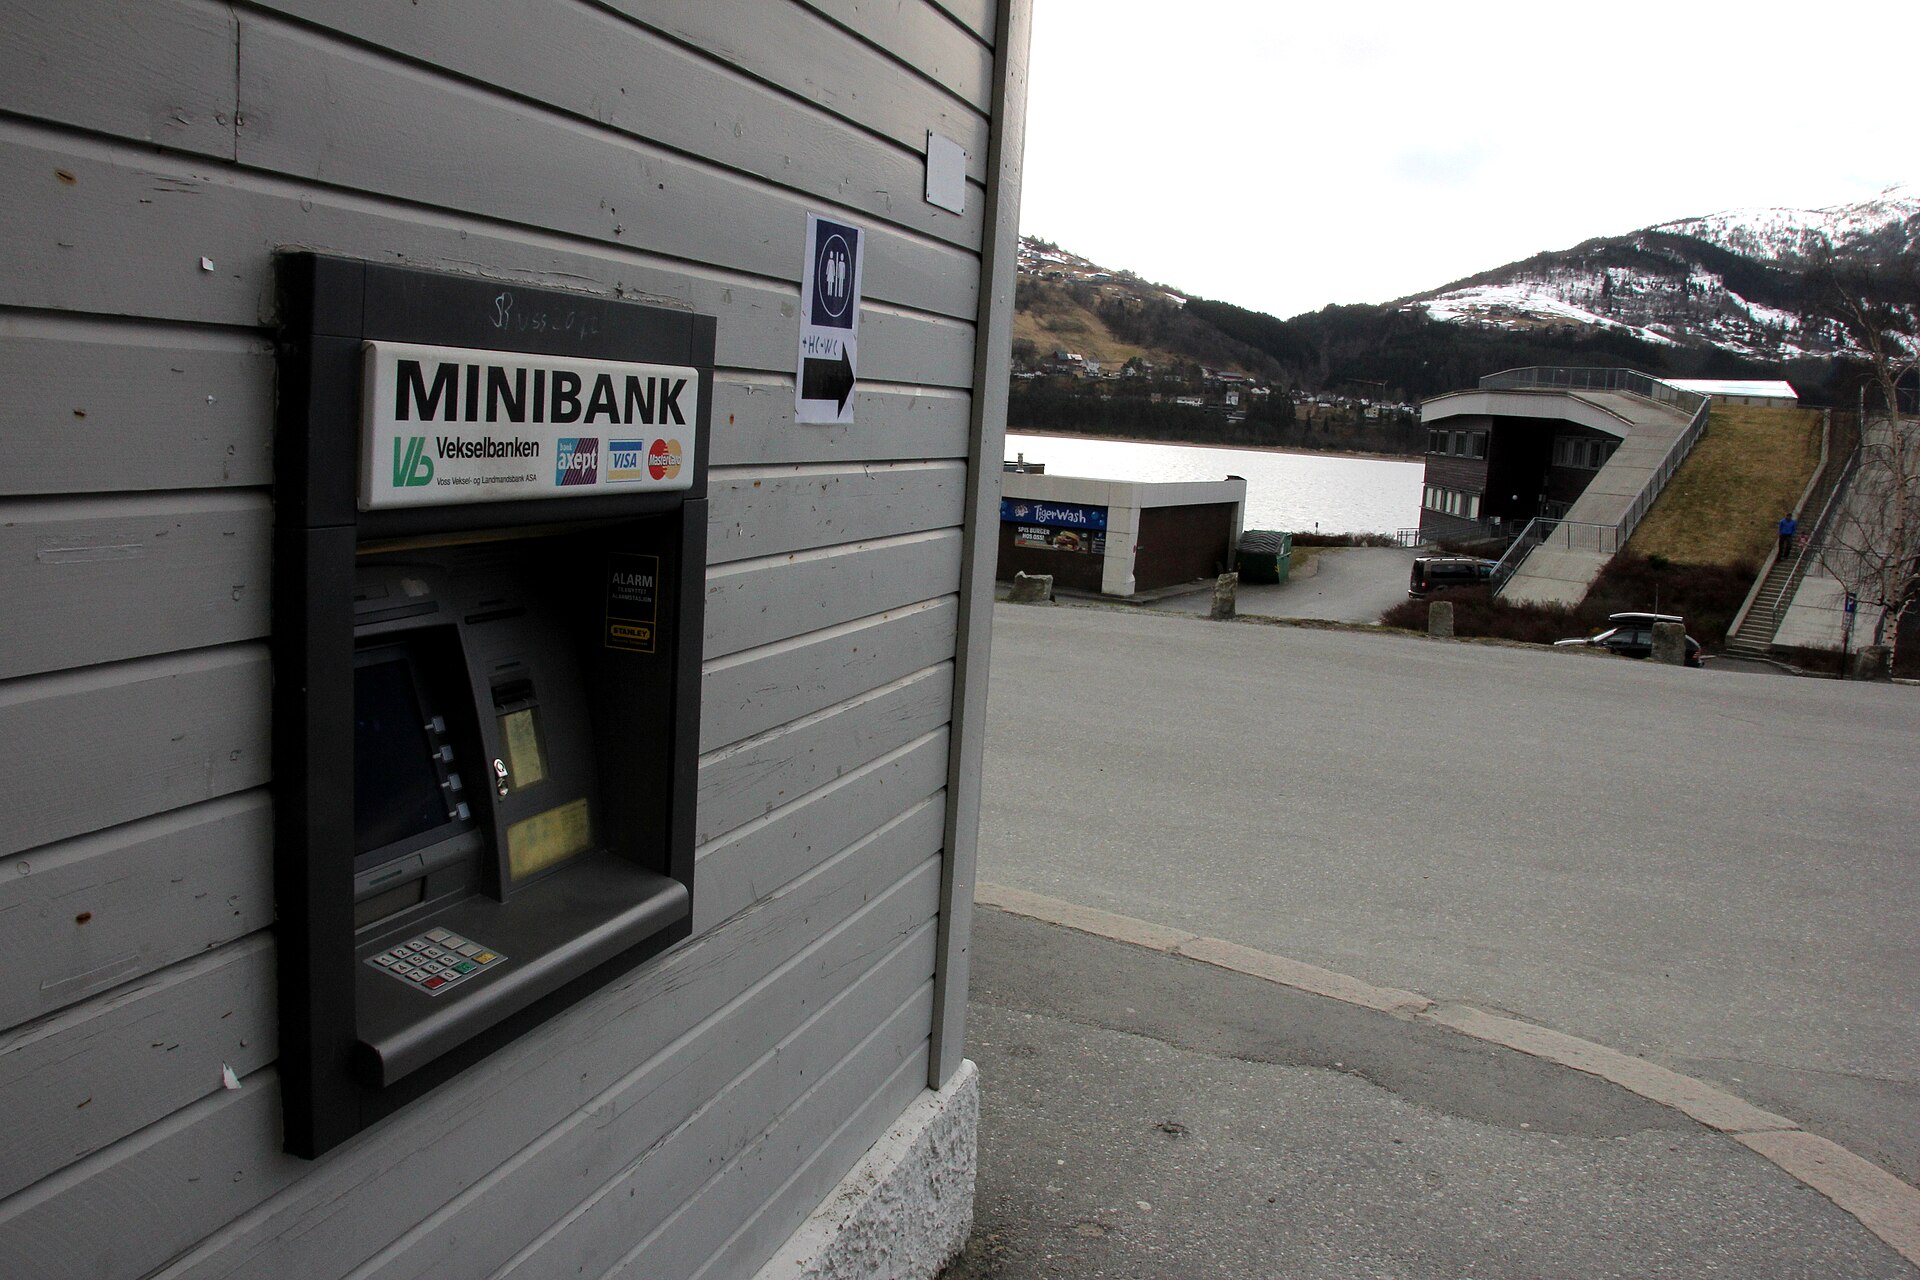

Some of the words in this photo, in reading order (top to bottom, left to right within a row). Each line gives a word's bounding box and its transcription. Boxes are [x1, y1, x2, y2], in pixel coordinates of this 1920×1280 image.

[395, 359, 688, 425] MINIBANK
[436, 437, 540, 459] Vekselbanken
[558, 447, 598, 478] axept
[613, 453, 637, 468] VISA
[649, 454, 682, 466] MasterCard
[437, 477, 450, 486] Voss
[452, 477, 471, 485] Veksel-
[474, 478, 481, 486] og
[482, 474, 524, 484] Landmandsbank
[525, 474, 537, 482] ASA
[1034, 504, 1086, 524] TigerWash
[1030, 527, 1050, 535] BURGER
[612, 572, 653, 587] ALARM
[1847, 598, 1854, 610] P
[613, 628, 647, 637] STANLEY
